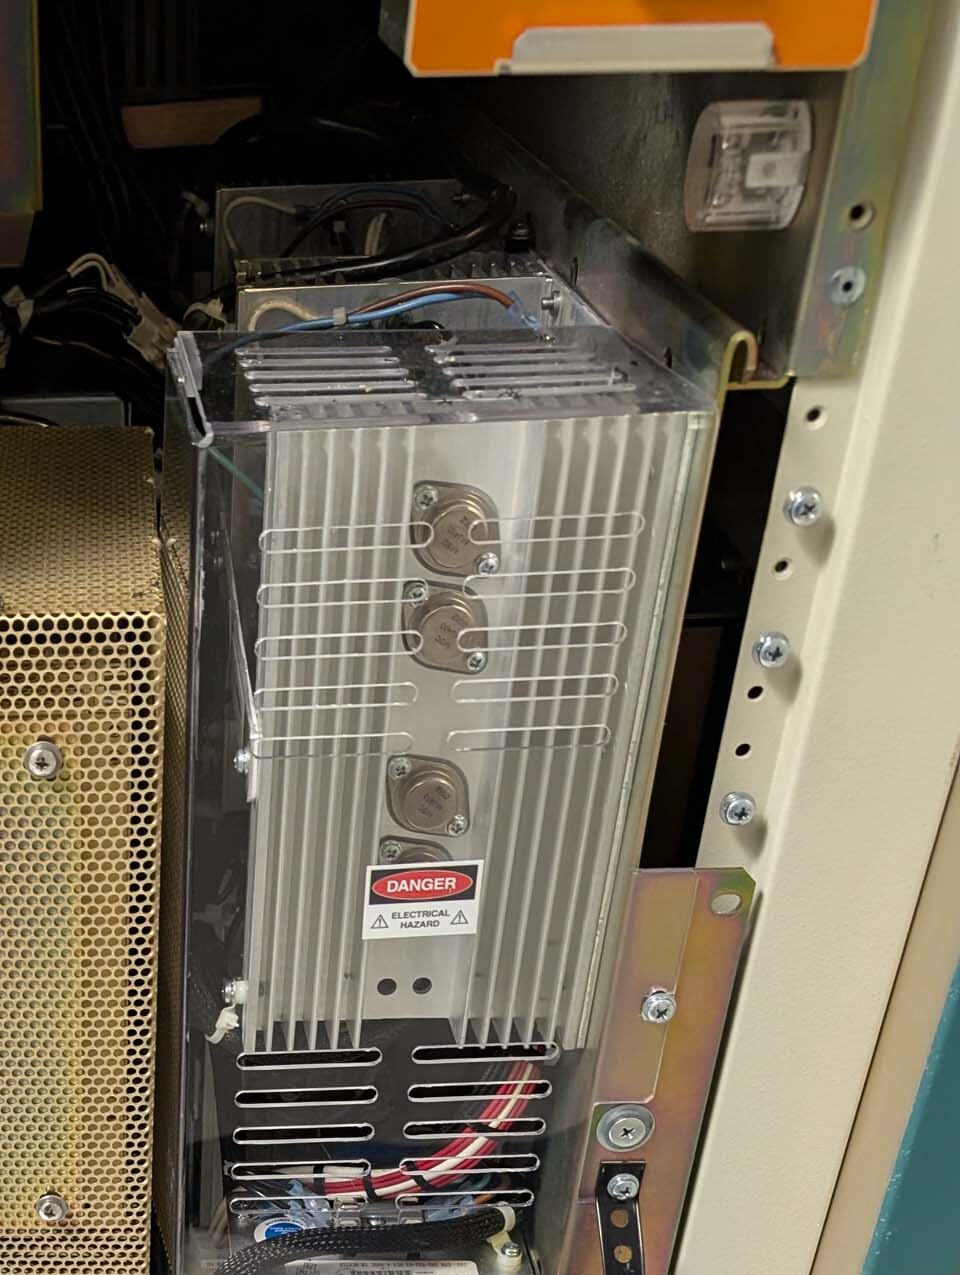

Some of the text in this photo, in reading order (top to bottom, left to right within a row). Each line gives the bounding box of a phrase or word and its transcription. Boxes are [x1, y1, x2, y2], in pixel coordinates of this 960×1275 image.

[386, 877, 457, 893] DANGER
[391, 909, 451, 920] ELECTRICAL
[400, 920, 440, 929] HAZARD
